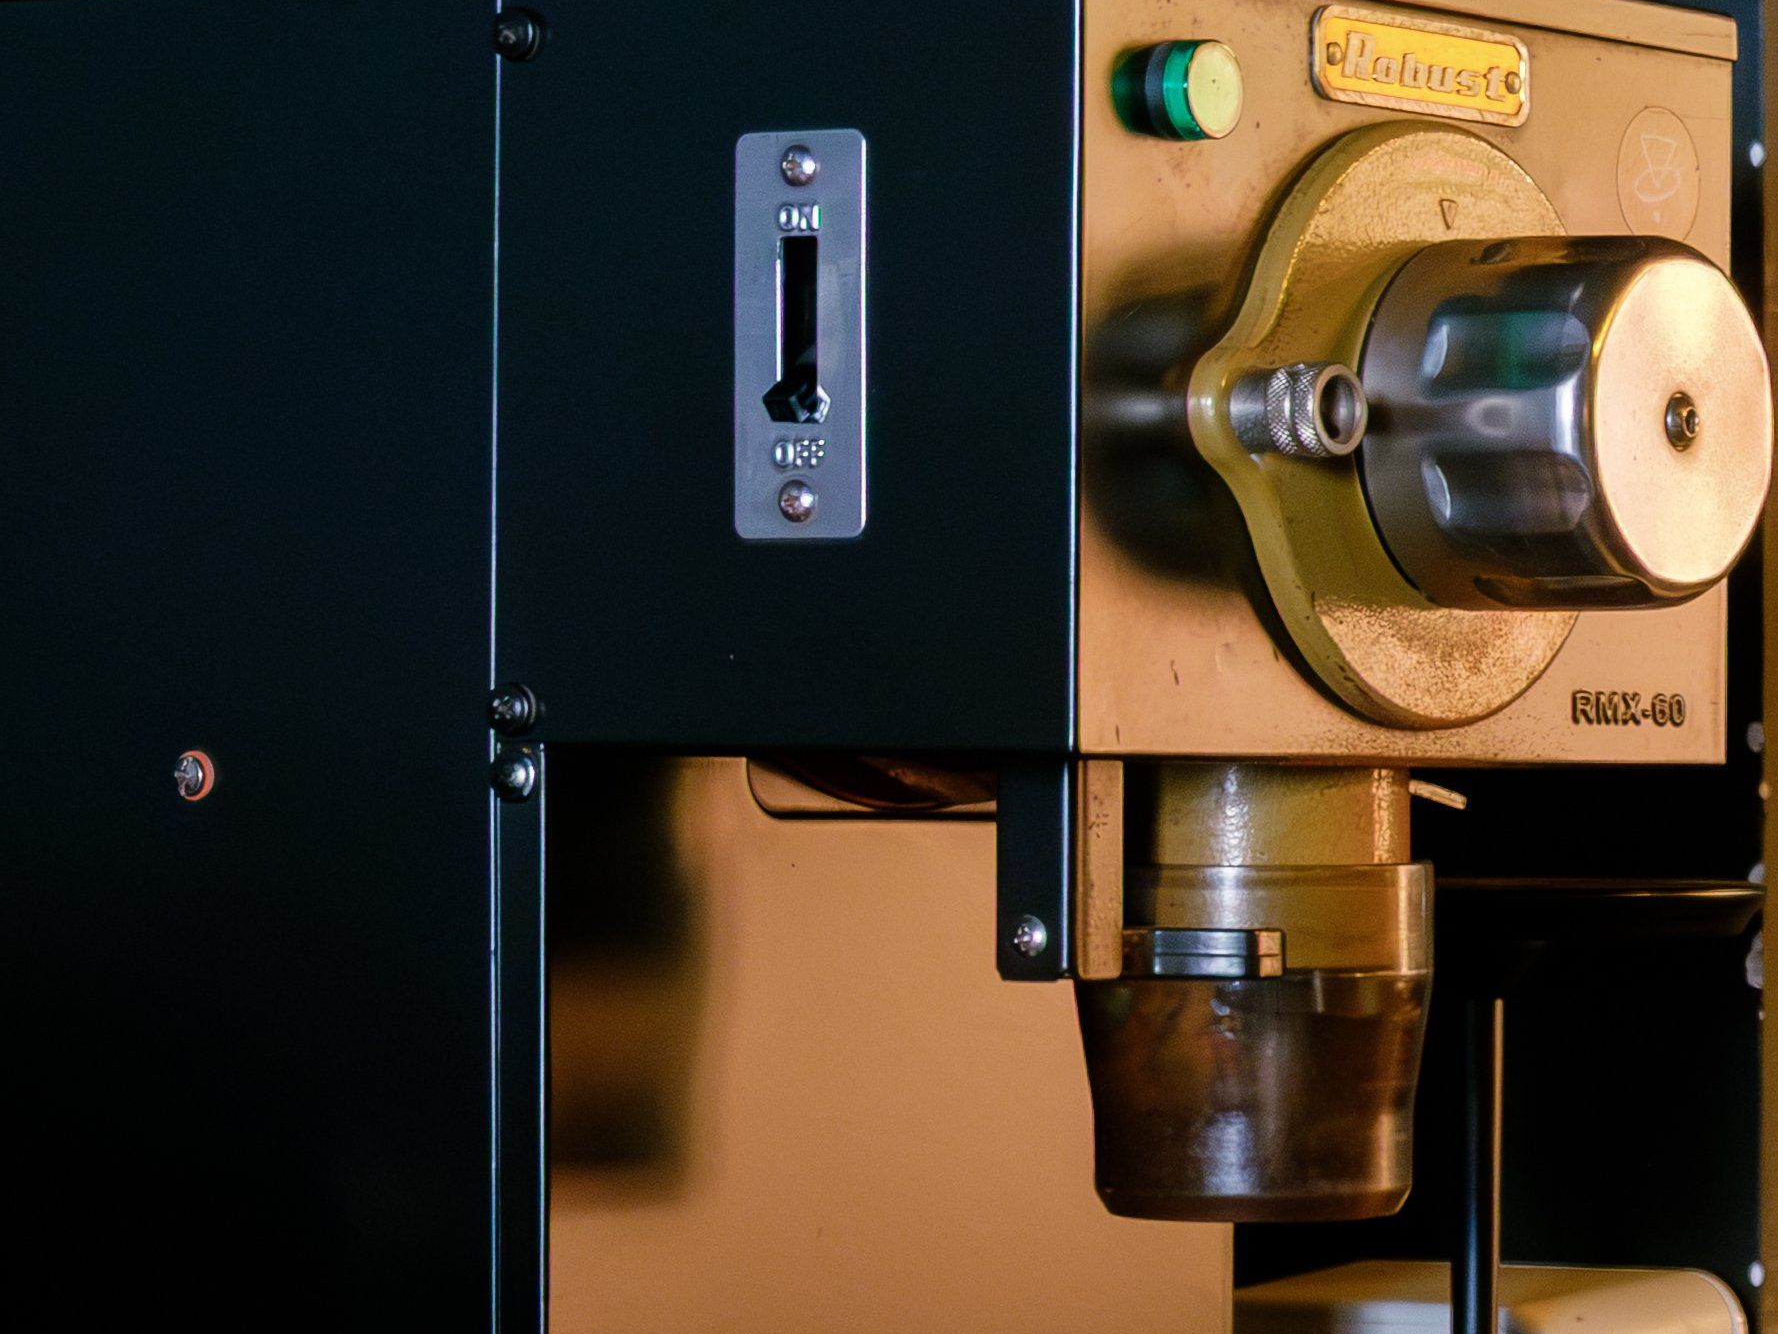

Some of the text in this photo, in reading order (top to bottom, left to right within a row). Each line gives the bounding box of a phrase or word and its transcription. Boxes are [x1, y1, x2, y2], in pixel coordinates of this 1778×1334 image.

[1341, 29, 1506, 103] Robust
[777, 203, 821, 231] ON
[773, 439, 826, 467] OFF
[1571, 689, 1687, 727] RMX-60
